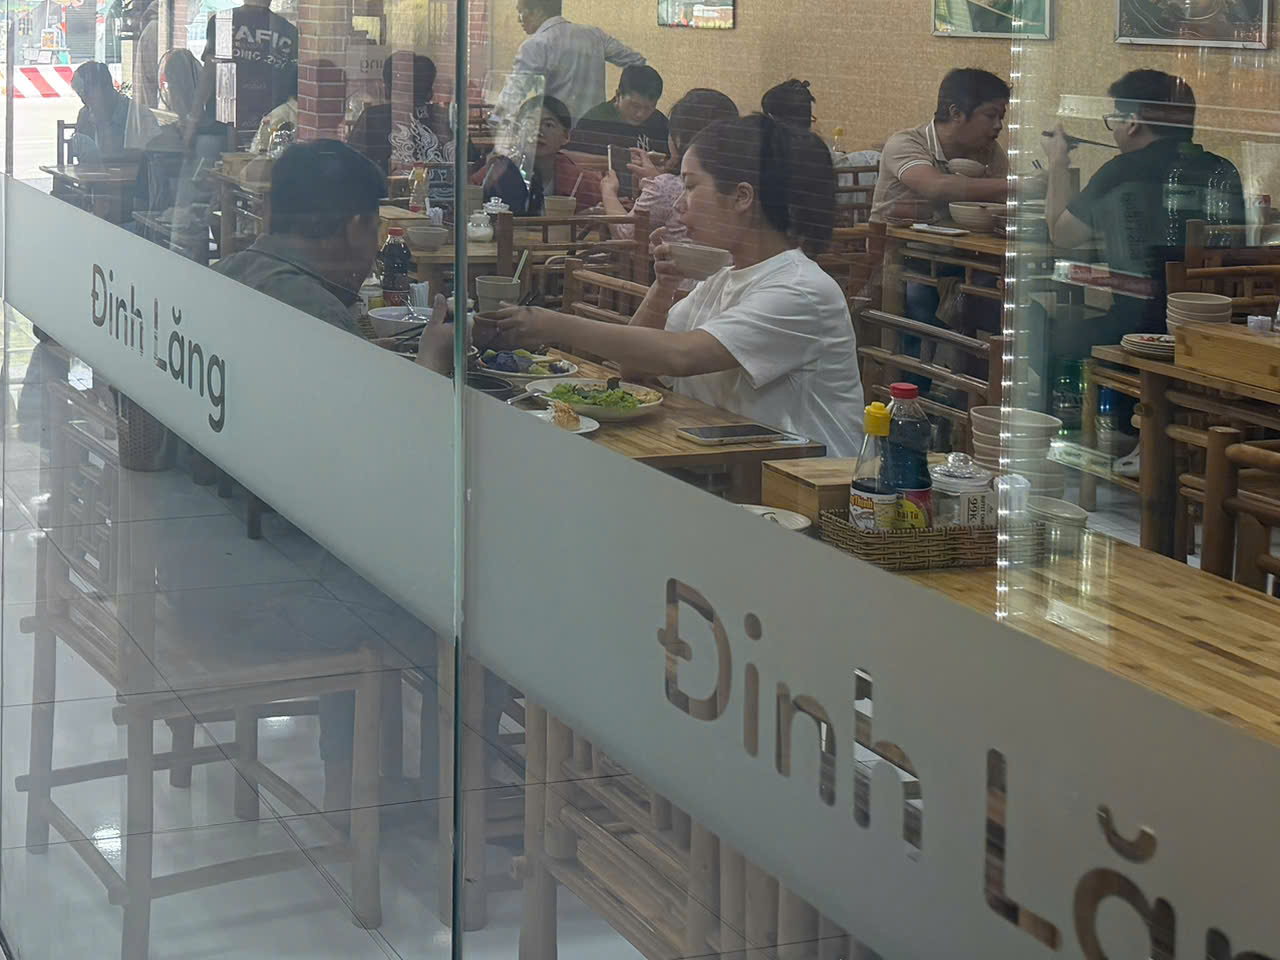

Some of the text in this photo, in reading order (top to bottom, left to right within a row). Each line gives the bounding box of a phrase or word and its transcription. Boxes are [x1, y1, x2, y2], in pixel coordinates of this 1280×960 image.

[91, 263, 226, 433] Đinh Lăng
[657, 577, 1280, 960] Đinh Lă
